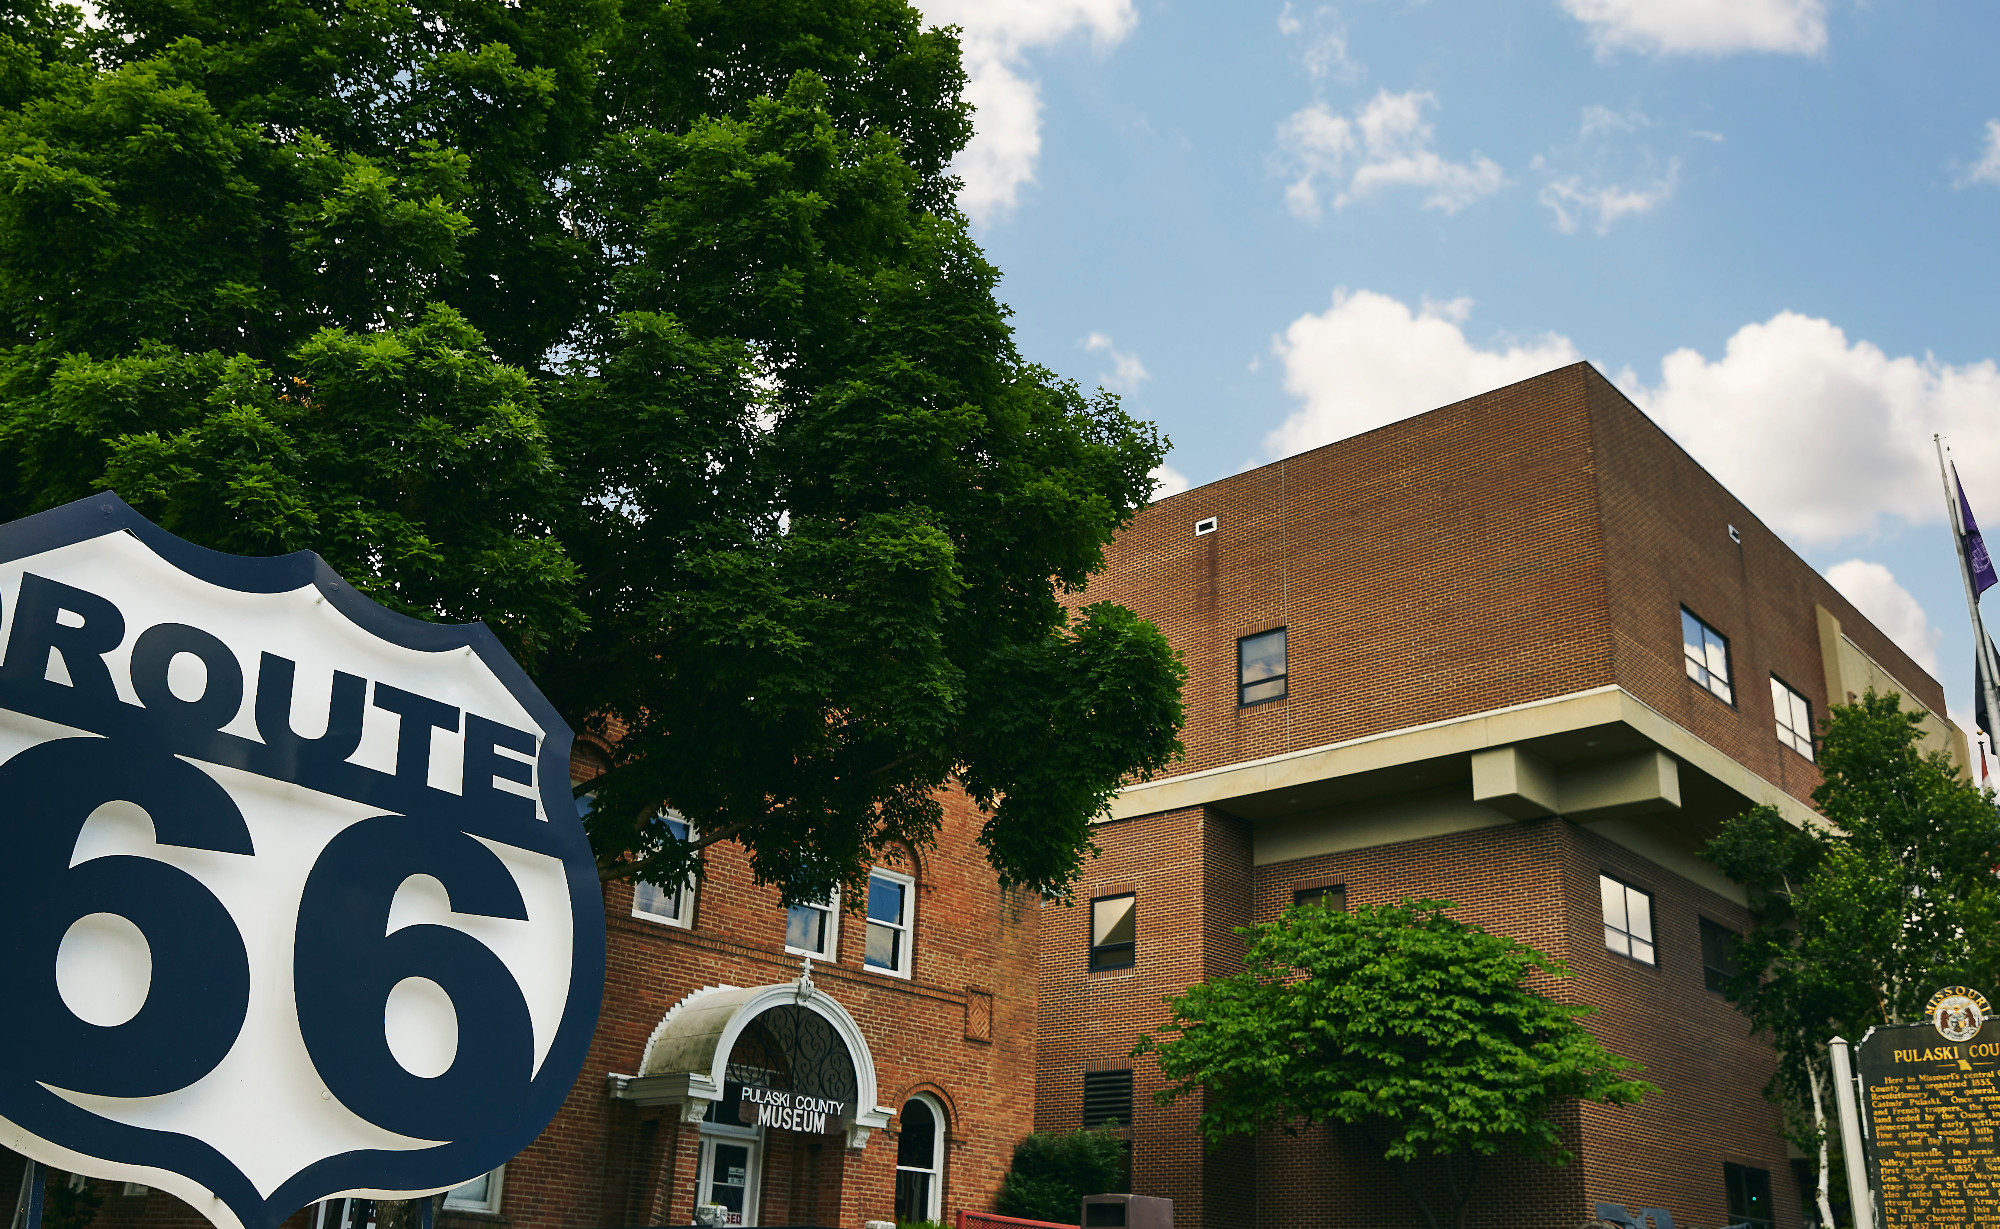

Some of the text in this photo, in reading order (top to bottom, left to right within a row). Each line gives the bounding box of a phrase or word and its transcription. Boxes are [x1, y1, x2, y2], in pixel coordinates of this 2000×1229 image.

[3, 571, 538, 822] ROUTE
[0, 735, 534, 1142] 66
[1925, 986, 1991, 1015] MISSOURI
[1894, 1046, 1959, 1063] PULASKI
[1884, 1076, 1904, 1084] Here
[1918, 1073, 1960, 1081] Missouri's
[1963, 1070, 1995, 1079] central
[1870, 1085, 1900, 1093] County
[1925, 1080, 1967, 1091] organized
[1871, 1092, 1929, 1100] Revolutionary
[742, 1086, 844, 1116] PULASKI COUNTY
[1871, 1100, 1903, 1108] Casimir
[1892, 1107, 1920, 1115] French
[757, 1103, 826, 1135] MUSEUM
[1896, 1114, 1920, 1122] ceded
[1924, 1113, 1936, 1121] by
[1960, 1111, 1987, 1119] Osage
[1875, 1124, 1910, 1132] pioneers
[1941, 1120, 1965, 1129] early
[1936, 1127, 1970, 1136] wooded
[1967, 1148, 1995, 1156] scenic
[1946, 1157, 1978, 1165] county
[1933, 1173, 1969, 1182] Anthony
[1882, 1183, 1904, 1191] stage
[1962, 1181, 1987, 1189] Louis
[1883, 1190, 1901, 1198] also
[1939, 1189, 1960, 1197] Wire
[1919, 1198, 1931, 1206] by
[1932, 1205, 1967, 1213] traveled
[1926, 1214, 1967, 1222] Cherokee
